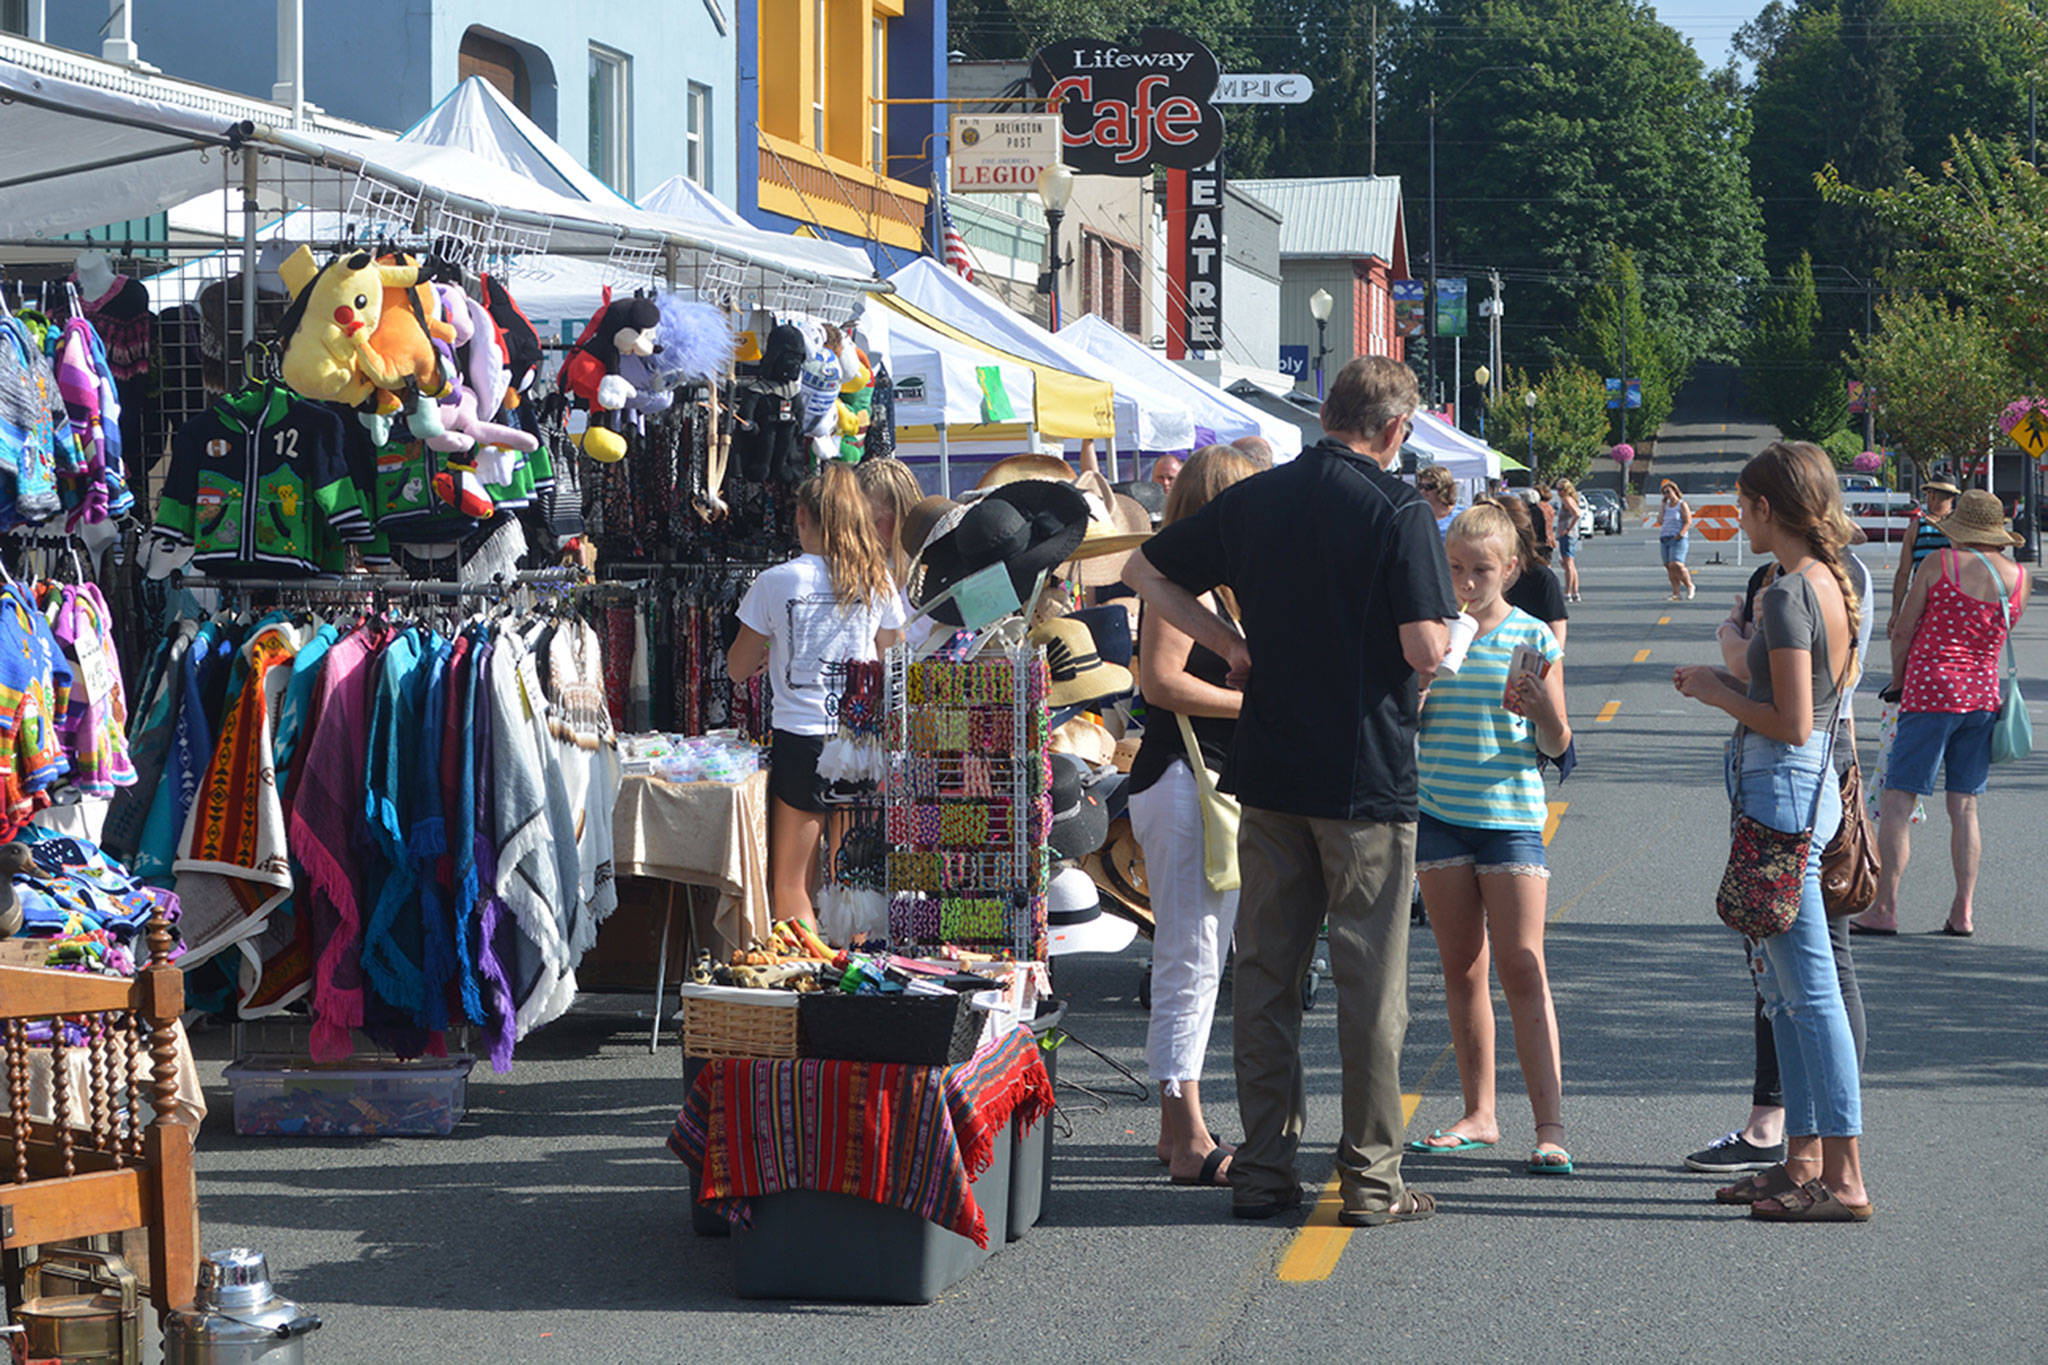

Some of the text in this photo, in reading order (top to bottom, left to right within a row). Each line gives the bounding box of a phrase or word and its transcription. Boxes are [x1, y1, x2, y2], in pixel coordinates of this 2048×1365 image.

[1073, 48, 1194, 72] Lifeway
[1217, 79, 1297, 99] MPIC
[995, 122, 1043, 134] ARLINGTON
[1045, 74, 1202, 164] Cafe
[1007, 137, 1032, 148] POST
[958, 165, 1046, 185] LEGIO
[1190, 159, 1217, 342] EATRE
[273, 428, 299, 458] 12
